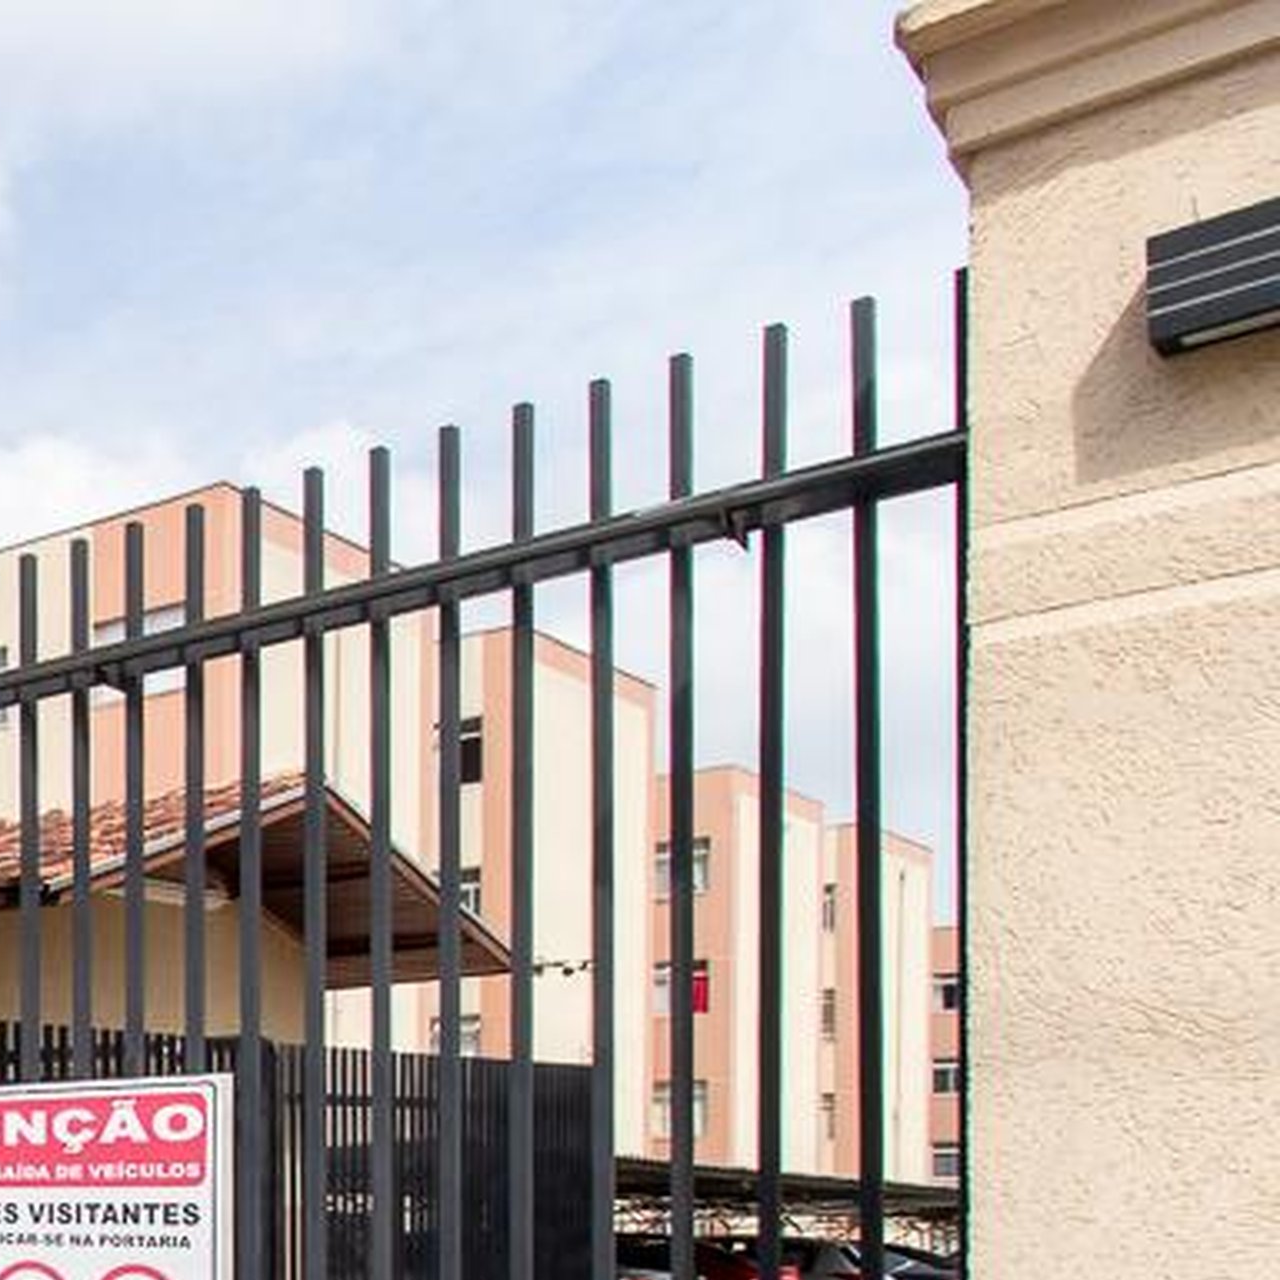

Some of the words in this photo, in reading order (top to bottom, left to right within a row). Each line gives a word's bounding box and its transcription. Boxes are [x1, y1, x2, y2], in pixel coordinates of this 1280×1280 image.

[54, 1164, 83, 1180] DE
[88, 1160, 200, 1179] VEÍCULOS
[28, 1202, 201, 1227] VISITANTES
[69, 1234, 94, 1247] NA
[99, 1234, 191, 1250] PORTARIA
